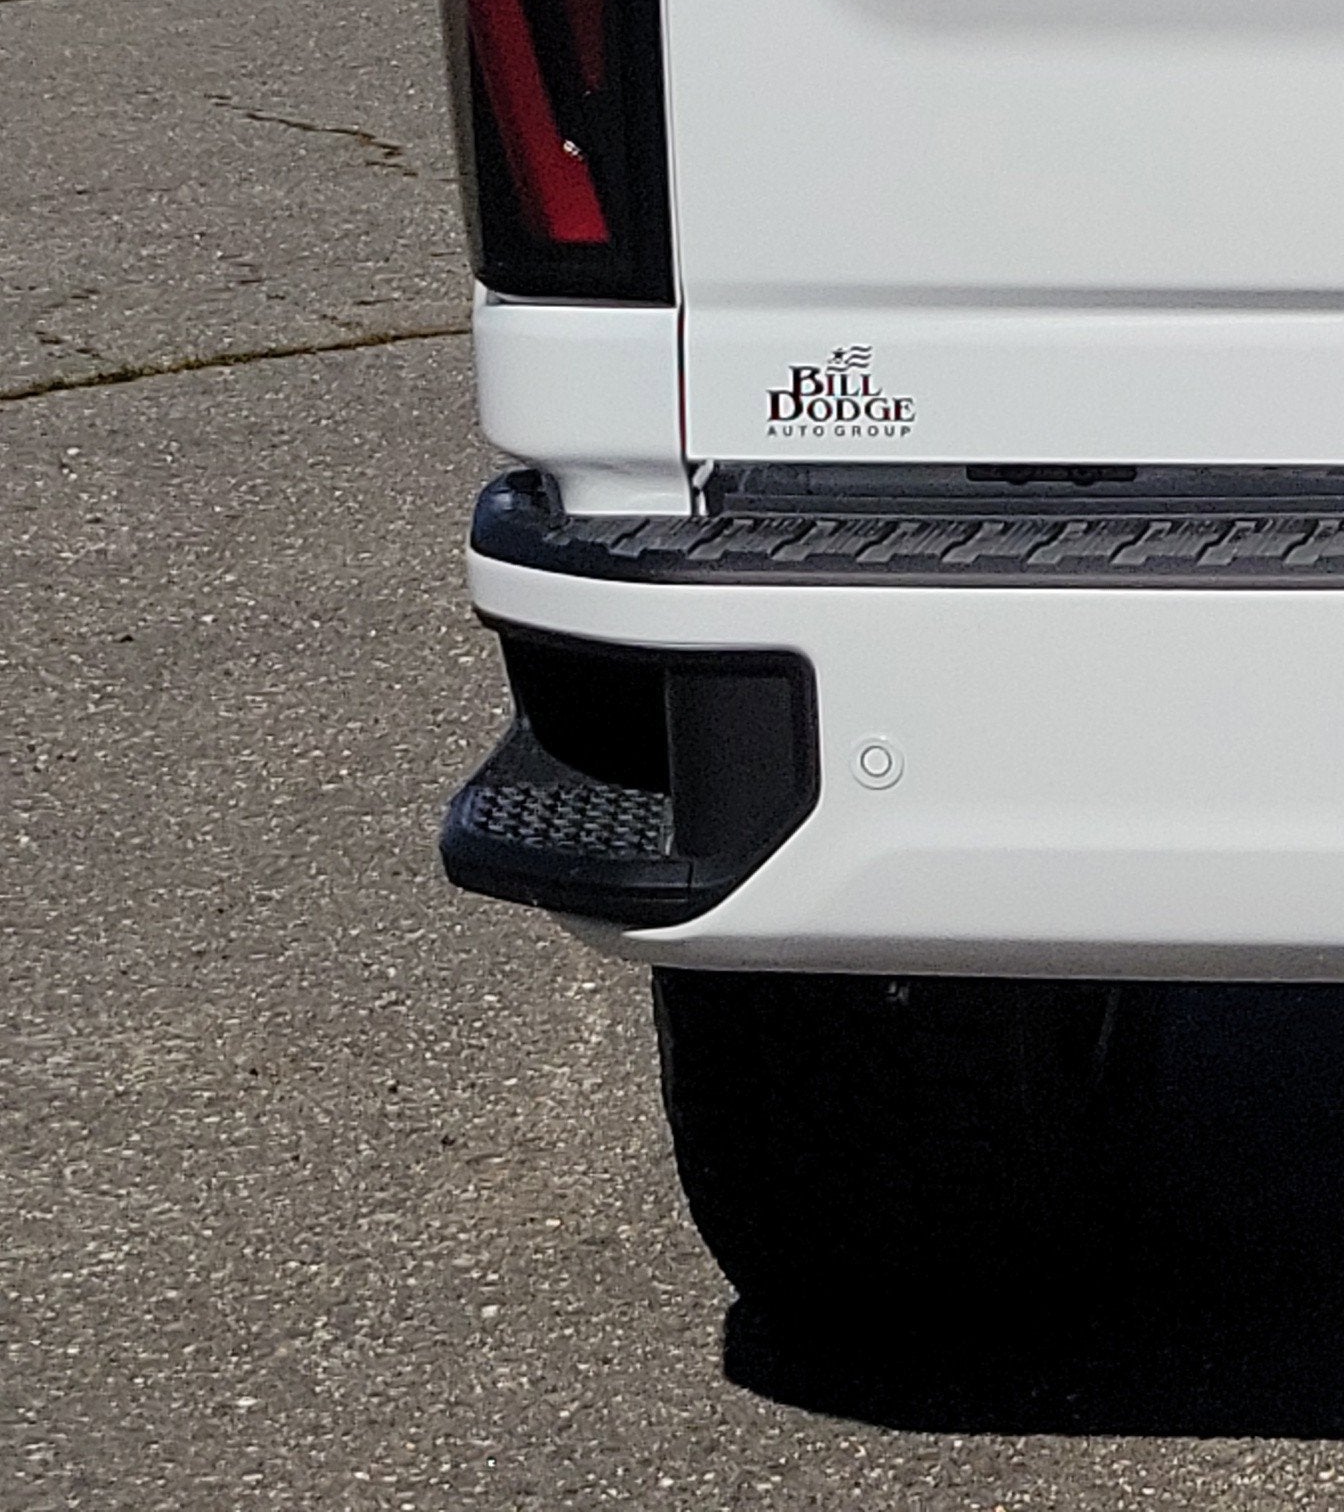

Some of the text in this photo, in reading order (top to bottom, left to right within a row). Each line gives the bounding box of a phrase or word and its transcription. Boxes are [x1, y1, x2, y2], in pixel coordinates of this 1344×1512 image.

[789, 365, 882, 397] BILL
[766, 389, 916, 422] DODGE
[767, 425, 911, 437] AUTO GROUP
